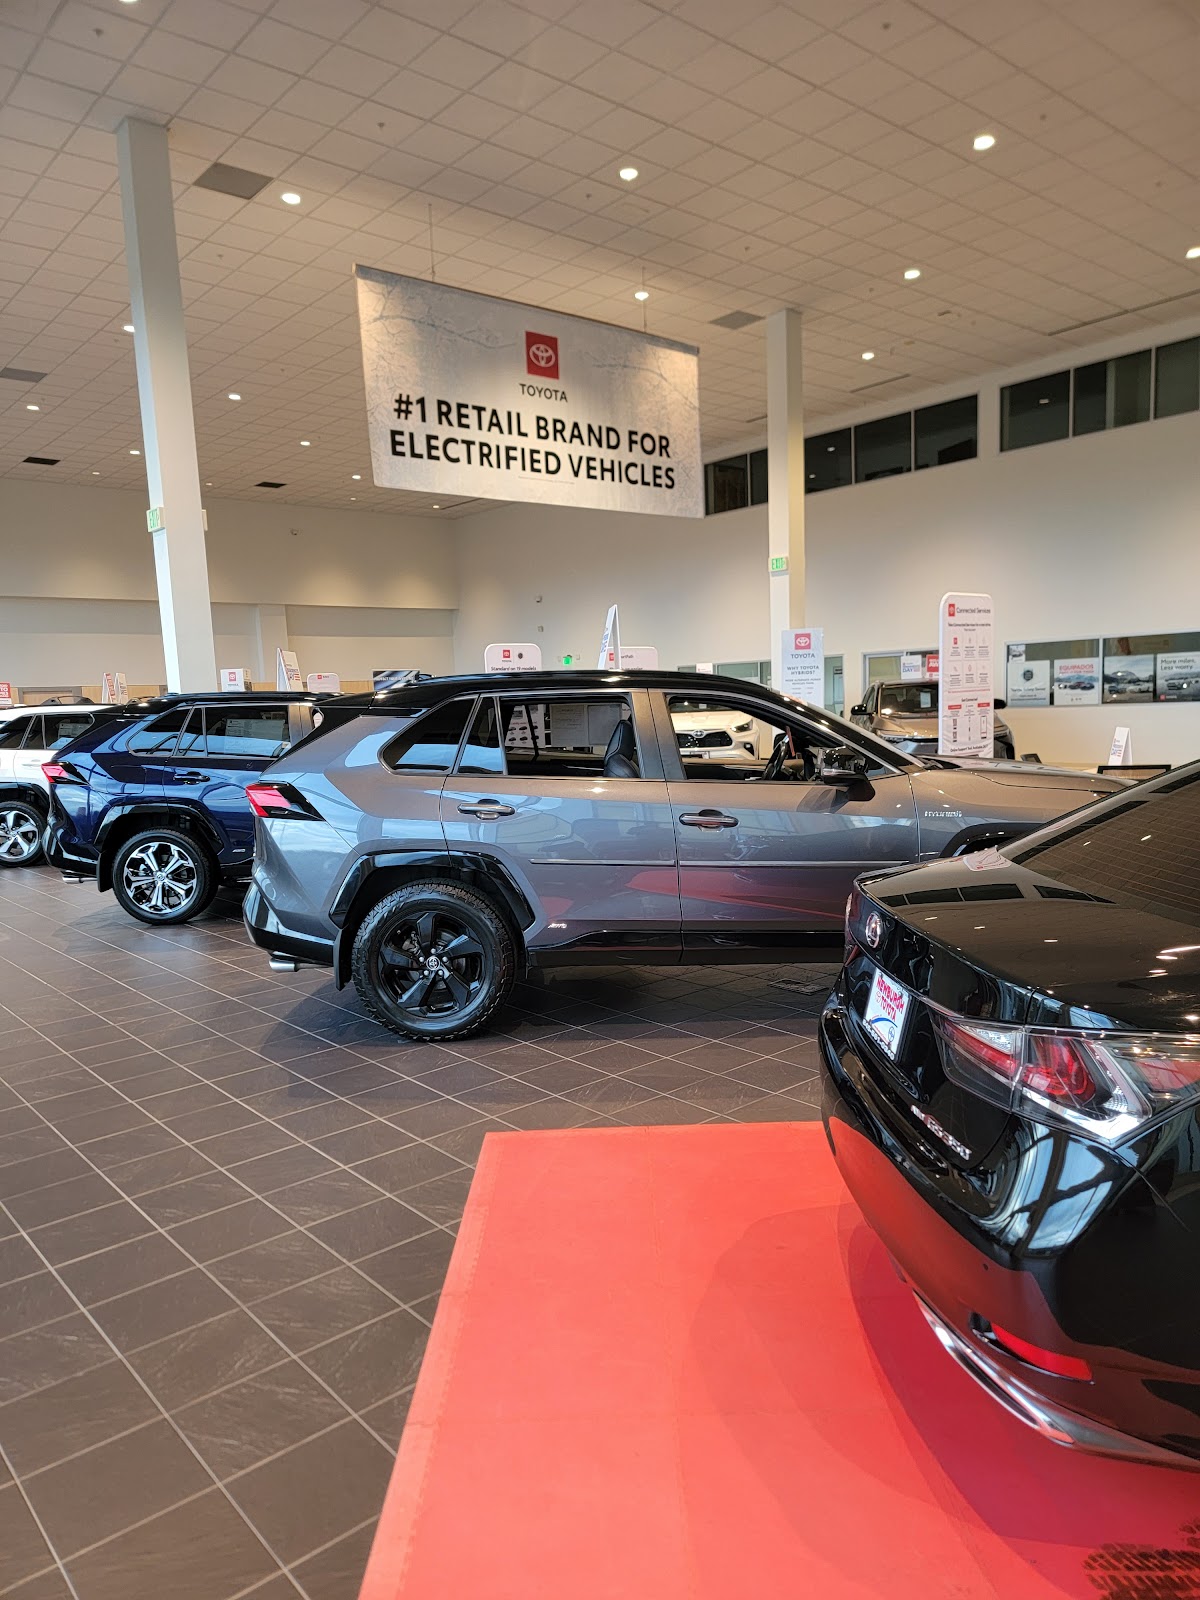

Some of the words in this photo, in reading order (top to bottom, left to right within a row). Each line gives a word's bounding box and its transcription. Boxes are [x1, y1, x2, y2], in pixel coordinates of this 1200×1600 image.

[519, 383, 568, 403] TOYOTA
[393, 393, 427, 423] #1
[437, 399, 529, 438] RETAIL
[536, 415, 621, 450] BRAND
[628, 430, 671, 458] FOR
[389, 429, 562, 476] ELECTRIFIED
[568, 453, 676, 489] VEHICLES
[771, 557, 785, 570] EXIT
[876, 976, 905, 1014] NEWBURGH
[880, 995, 897, 1022] TOYOTA
